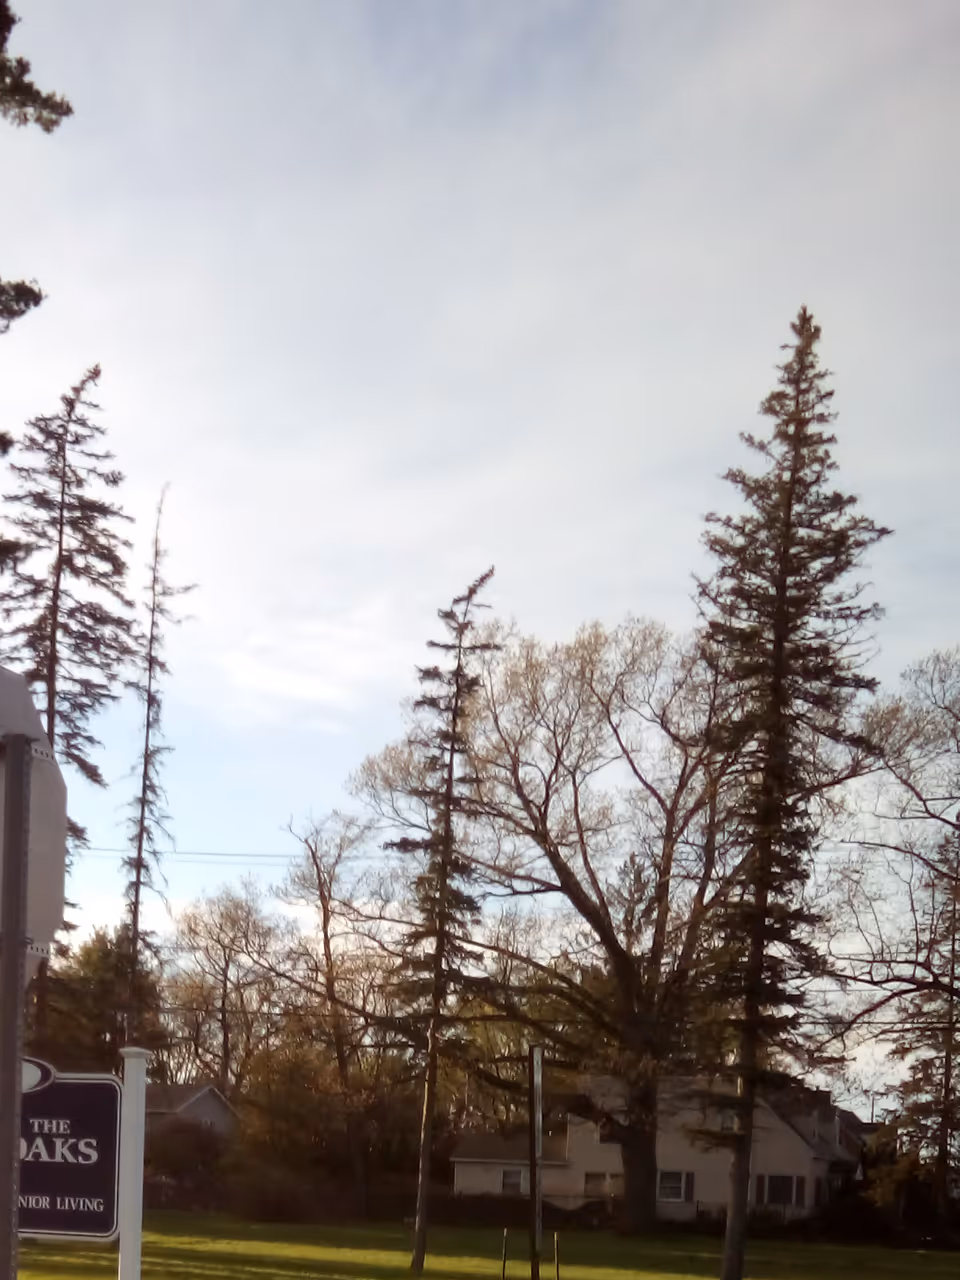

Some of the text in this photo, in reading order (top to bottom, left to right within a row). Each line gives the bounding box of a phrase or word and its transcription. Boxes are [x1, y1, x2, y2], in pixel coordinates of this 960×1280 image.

[30, 1119, 71, 1134] THE
[18, 1194, 51, 1209] NIOR
[57, 1196, 105, 1212] LIVING
